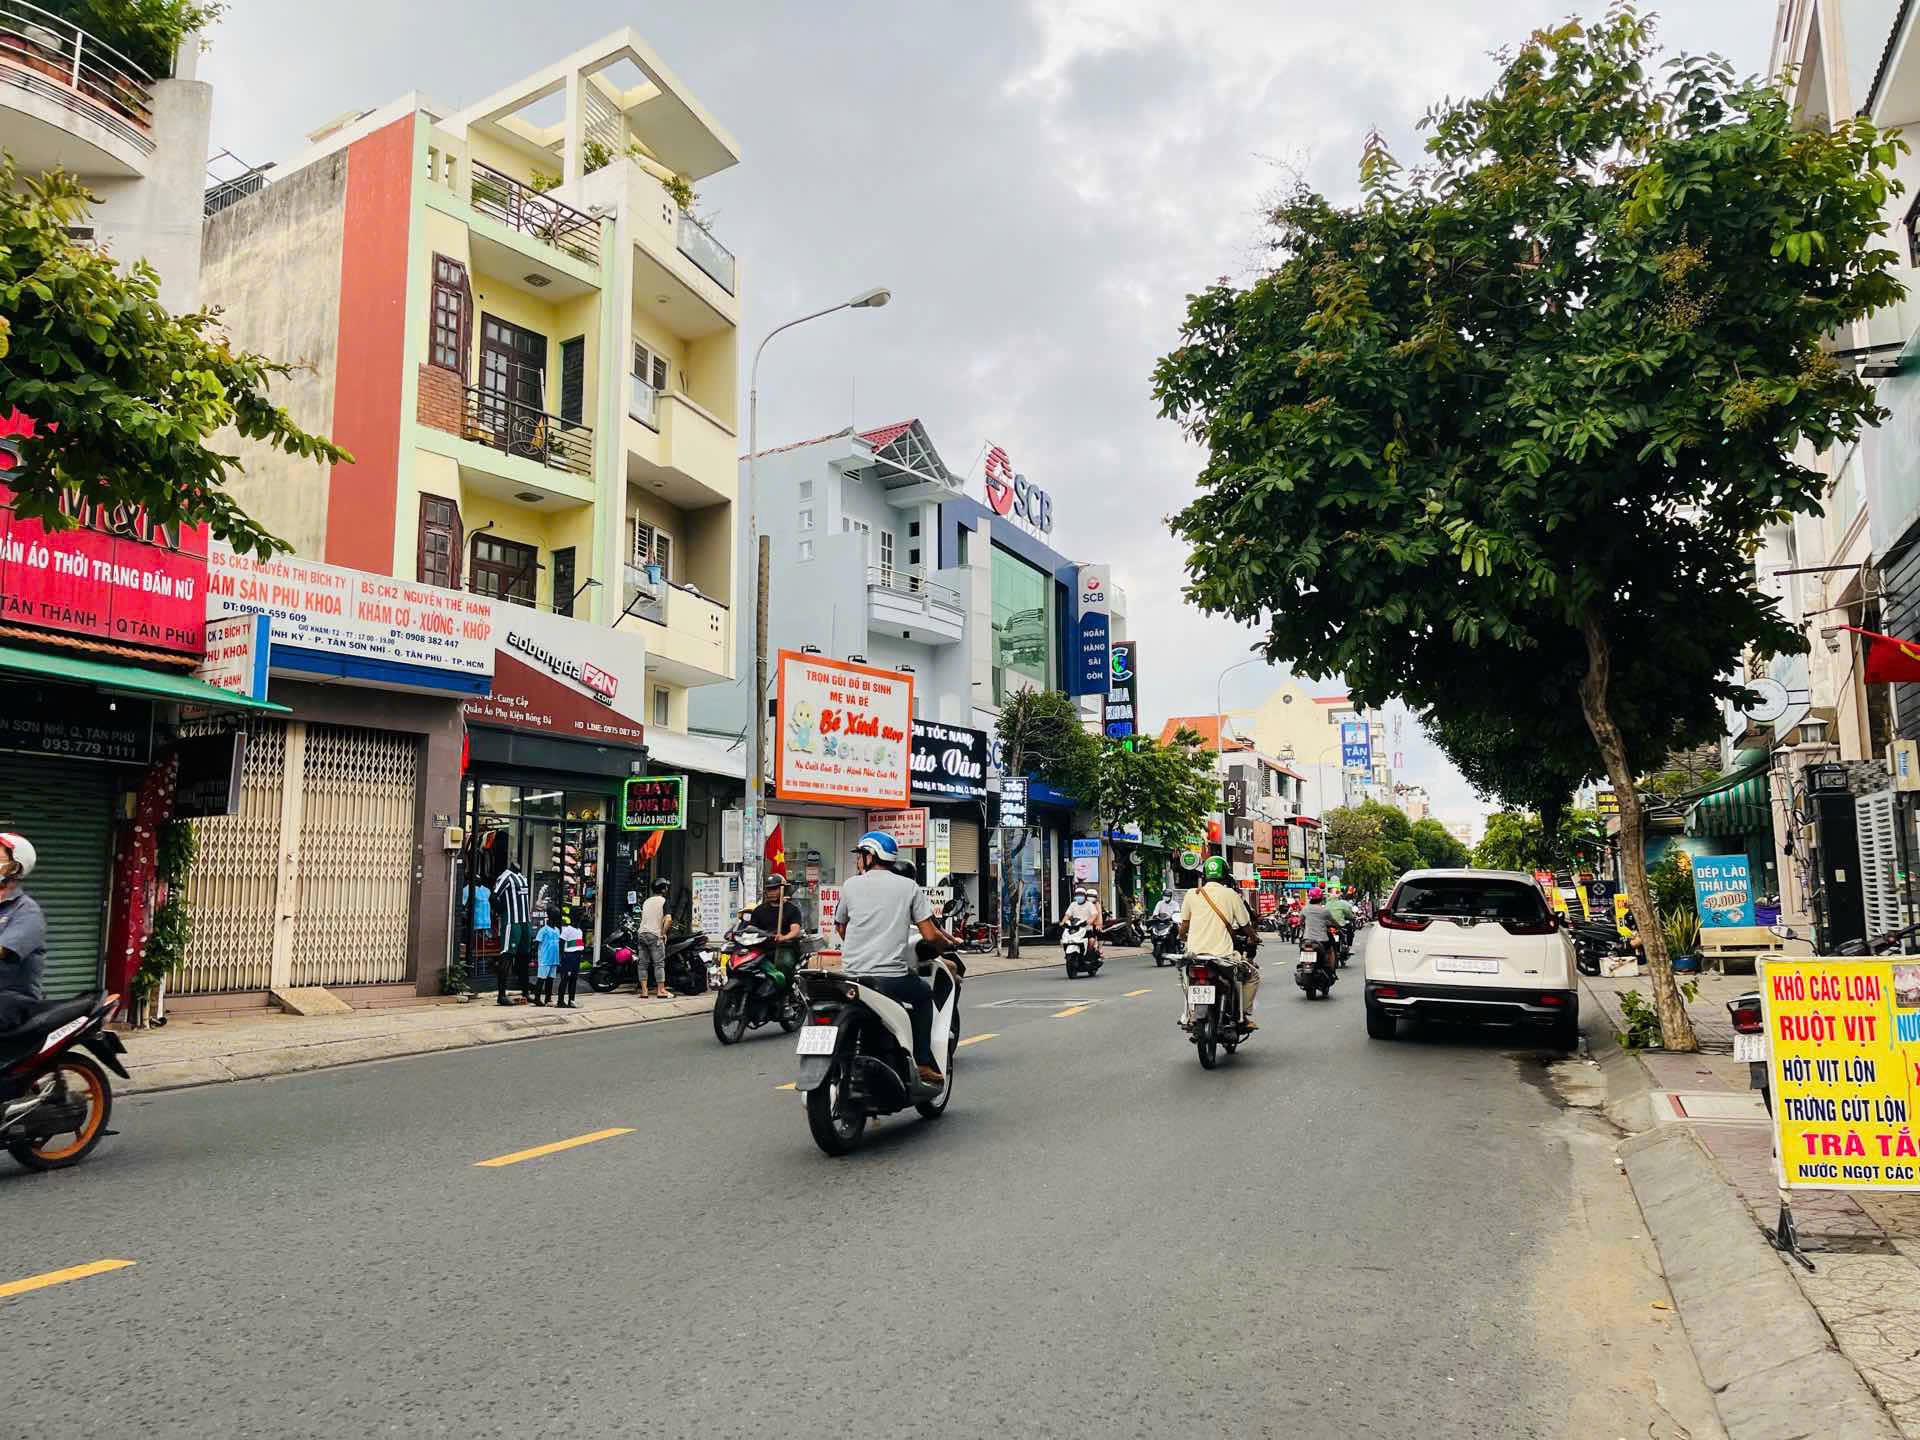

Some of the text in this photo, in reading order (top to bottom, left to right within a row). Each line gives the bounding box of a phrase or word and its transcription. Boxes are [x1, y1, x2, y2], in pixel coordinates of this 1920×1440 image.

[1013, 473, 1053, 534] SCB
[27, 541, 49, 569] ÁO
[53, 550, 89, 578] THỜI
[92, 560, 139, 589] TRANG
[175, 576, 195, 600] NỮ
[212, 551, 226, 566] BS
[229, 555, 249, 570] CK2
[311, 570, 332, 586] BÍCH
[239, 575, 269, 603] SẢN
[305, 591, 342, 616] KHOA
[362, 582, 375, 594] BS
[1082, 592, 1104, 604] SCB
[289, 612, 307, 622] 609
[219, 629, 223, 640] 2
[444, 639, 459, 648] 447
[1083, 643, 1105, 652] HÀNG
[223, 644, 248, 660] KHOA
[466, 660, 484, 669] HCM
[1088, 656, 1101, 665] SÀI
[872, 683, 892, 695] SINH
[497, 694, 514, 706] Cung
[819, 708, 842, 735] Bé
[927, 725, 947, 740] TÓC
[1345, 746, 1368, 756] TÂN
[1698, 878, 1748, 892] THÁI LAN
[1773, 970, 1881, 1007] KHÔ CÁC LOẠI
[1779, 1010, 1877, 1047] RUỘT VỊT
[1782, 1054, 1876, 1087] HỘT VỊT LỘN
[1784, 1093, 1837, 1121] TRỨNG
[1875, 1095, 1906, 1127] LỘN
[1801, 1126, 1920, 1156] TRÀ TẮ
[1799, 1162, 1913, 1182] NƯỚC NGỌT CÁC
